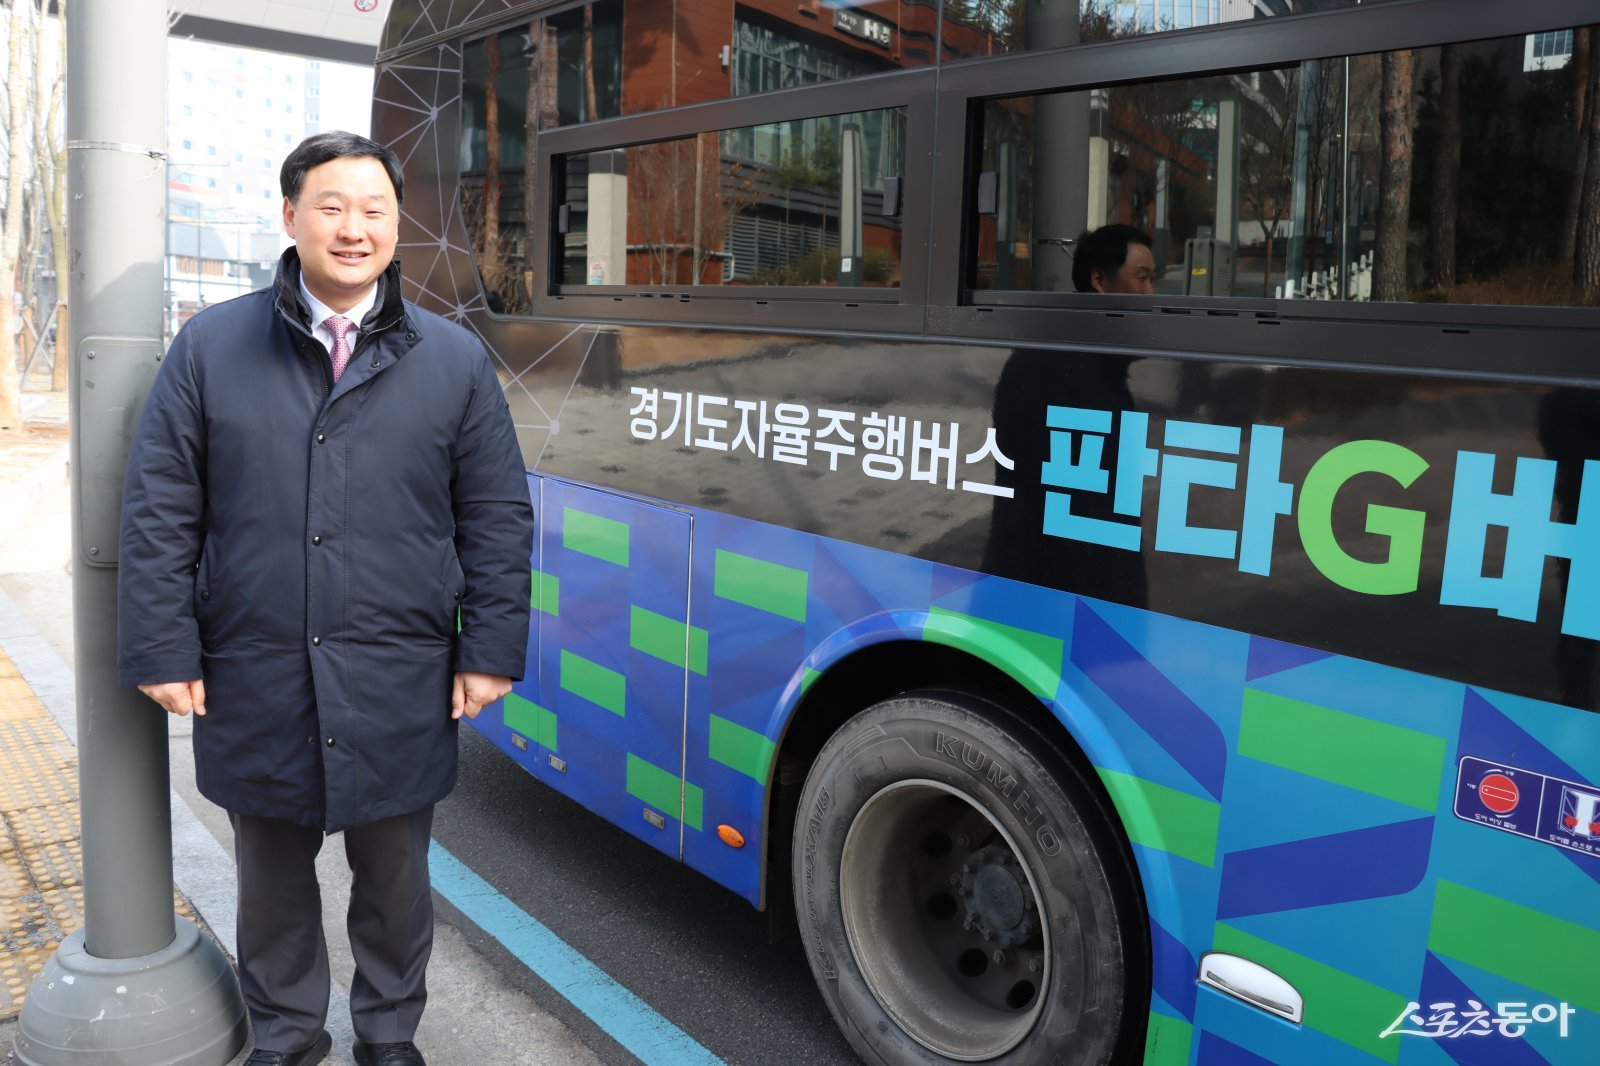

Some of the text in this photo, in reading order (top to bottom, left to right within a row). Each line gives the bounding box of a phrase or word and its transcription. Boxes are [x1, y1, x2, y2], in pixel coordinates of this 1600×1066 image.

[629, 386, 1015, 499] 경기도자율주행버스
[935, 731, 1062, 857] KUMHO
[1474, 813, 1488, 822] 도어
[1571, 841, 1593, 852] 손으로
